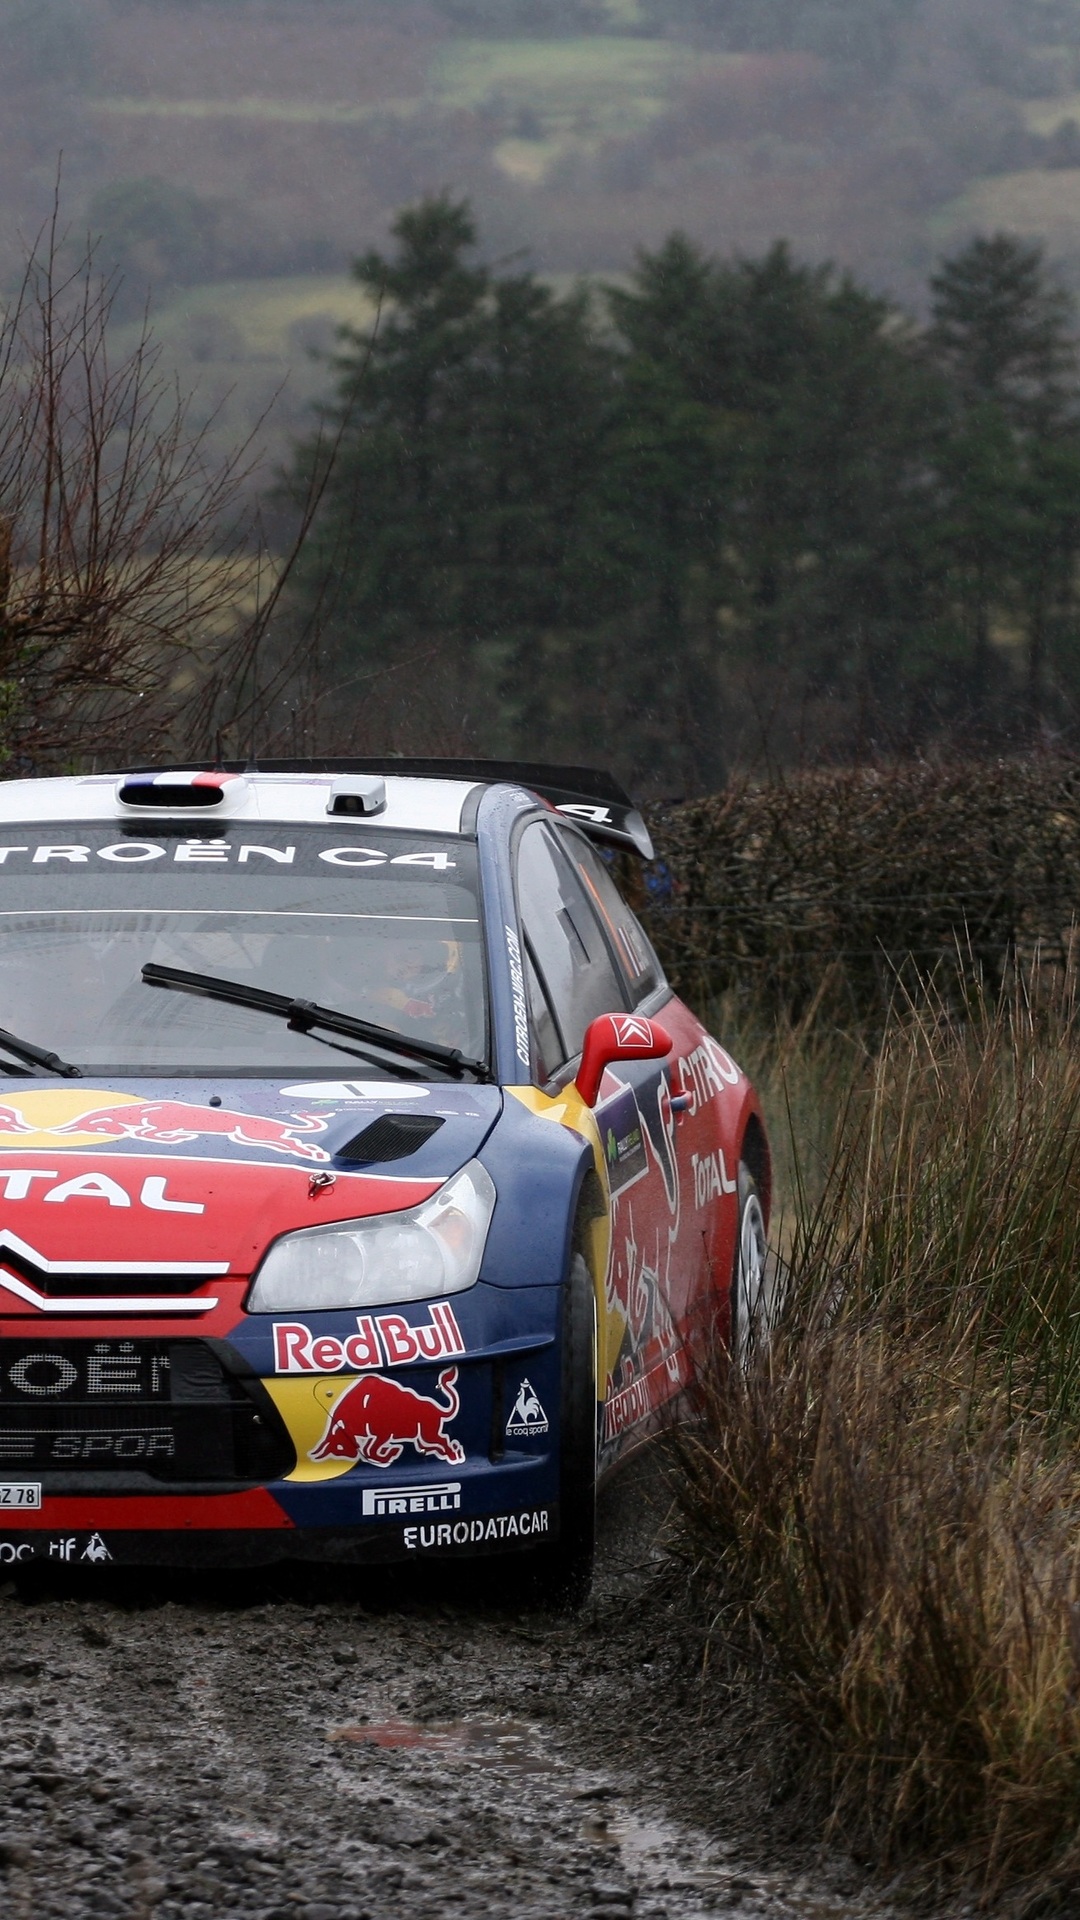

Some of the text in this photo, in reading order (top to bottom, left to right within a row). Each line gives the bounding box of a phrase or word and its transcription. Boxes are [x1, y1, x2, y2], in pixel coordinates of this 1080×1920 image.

[318, 847, 456, 870] C4
[691, 1148, 737, 1211] TOTAL
[17, 1489, 34, 1504] 78
[362, 1482, 461, 1516] PIRELLI
[403, 1510, 549, 1549] EURODATACAR
